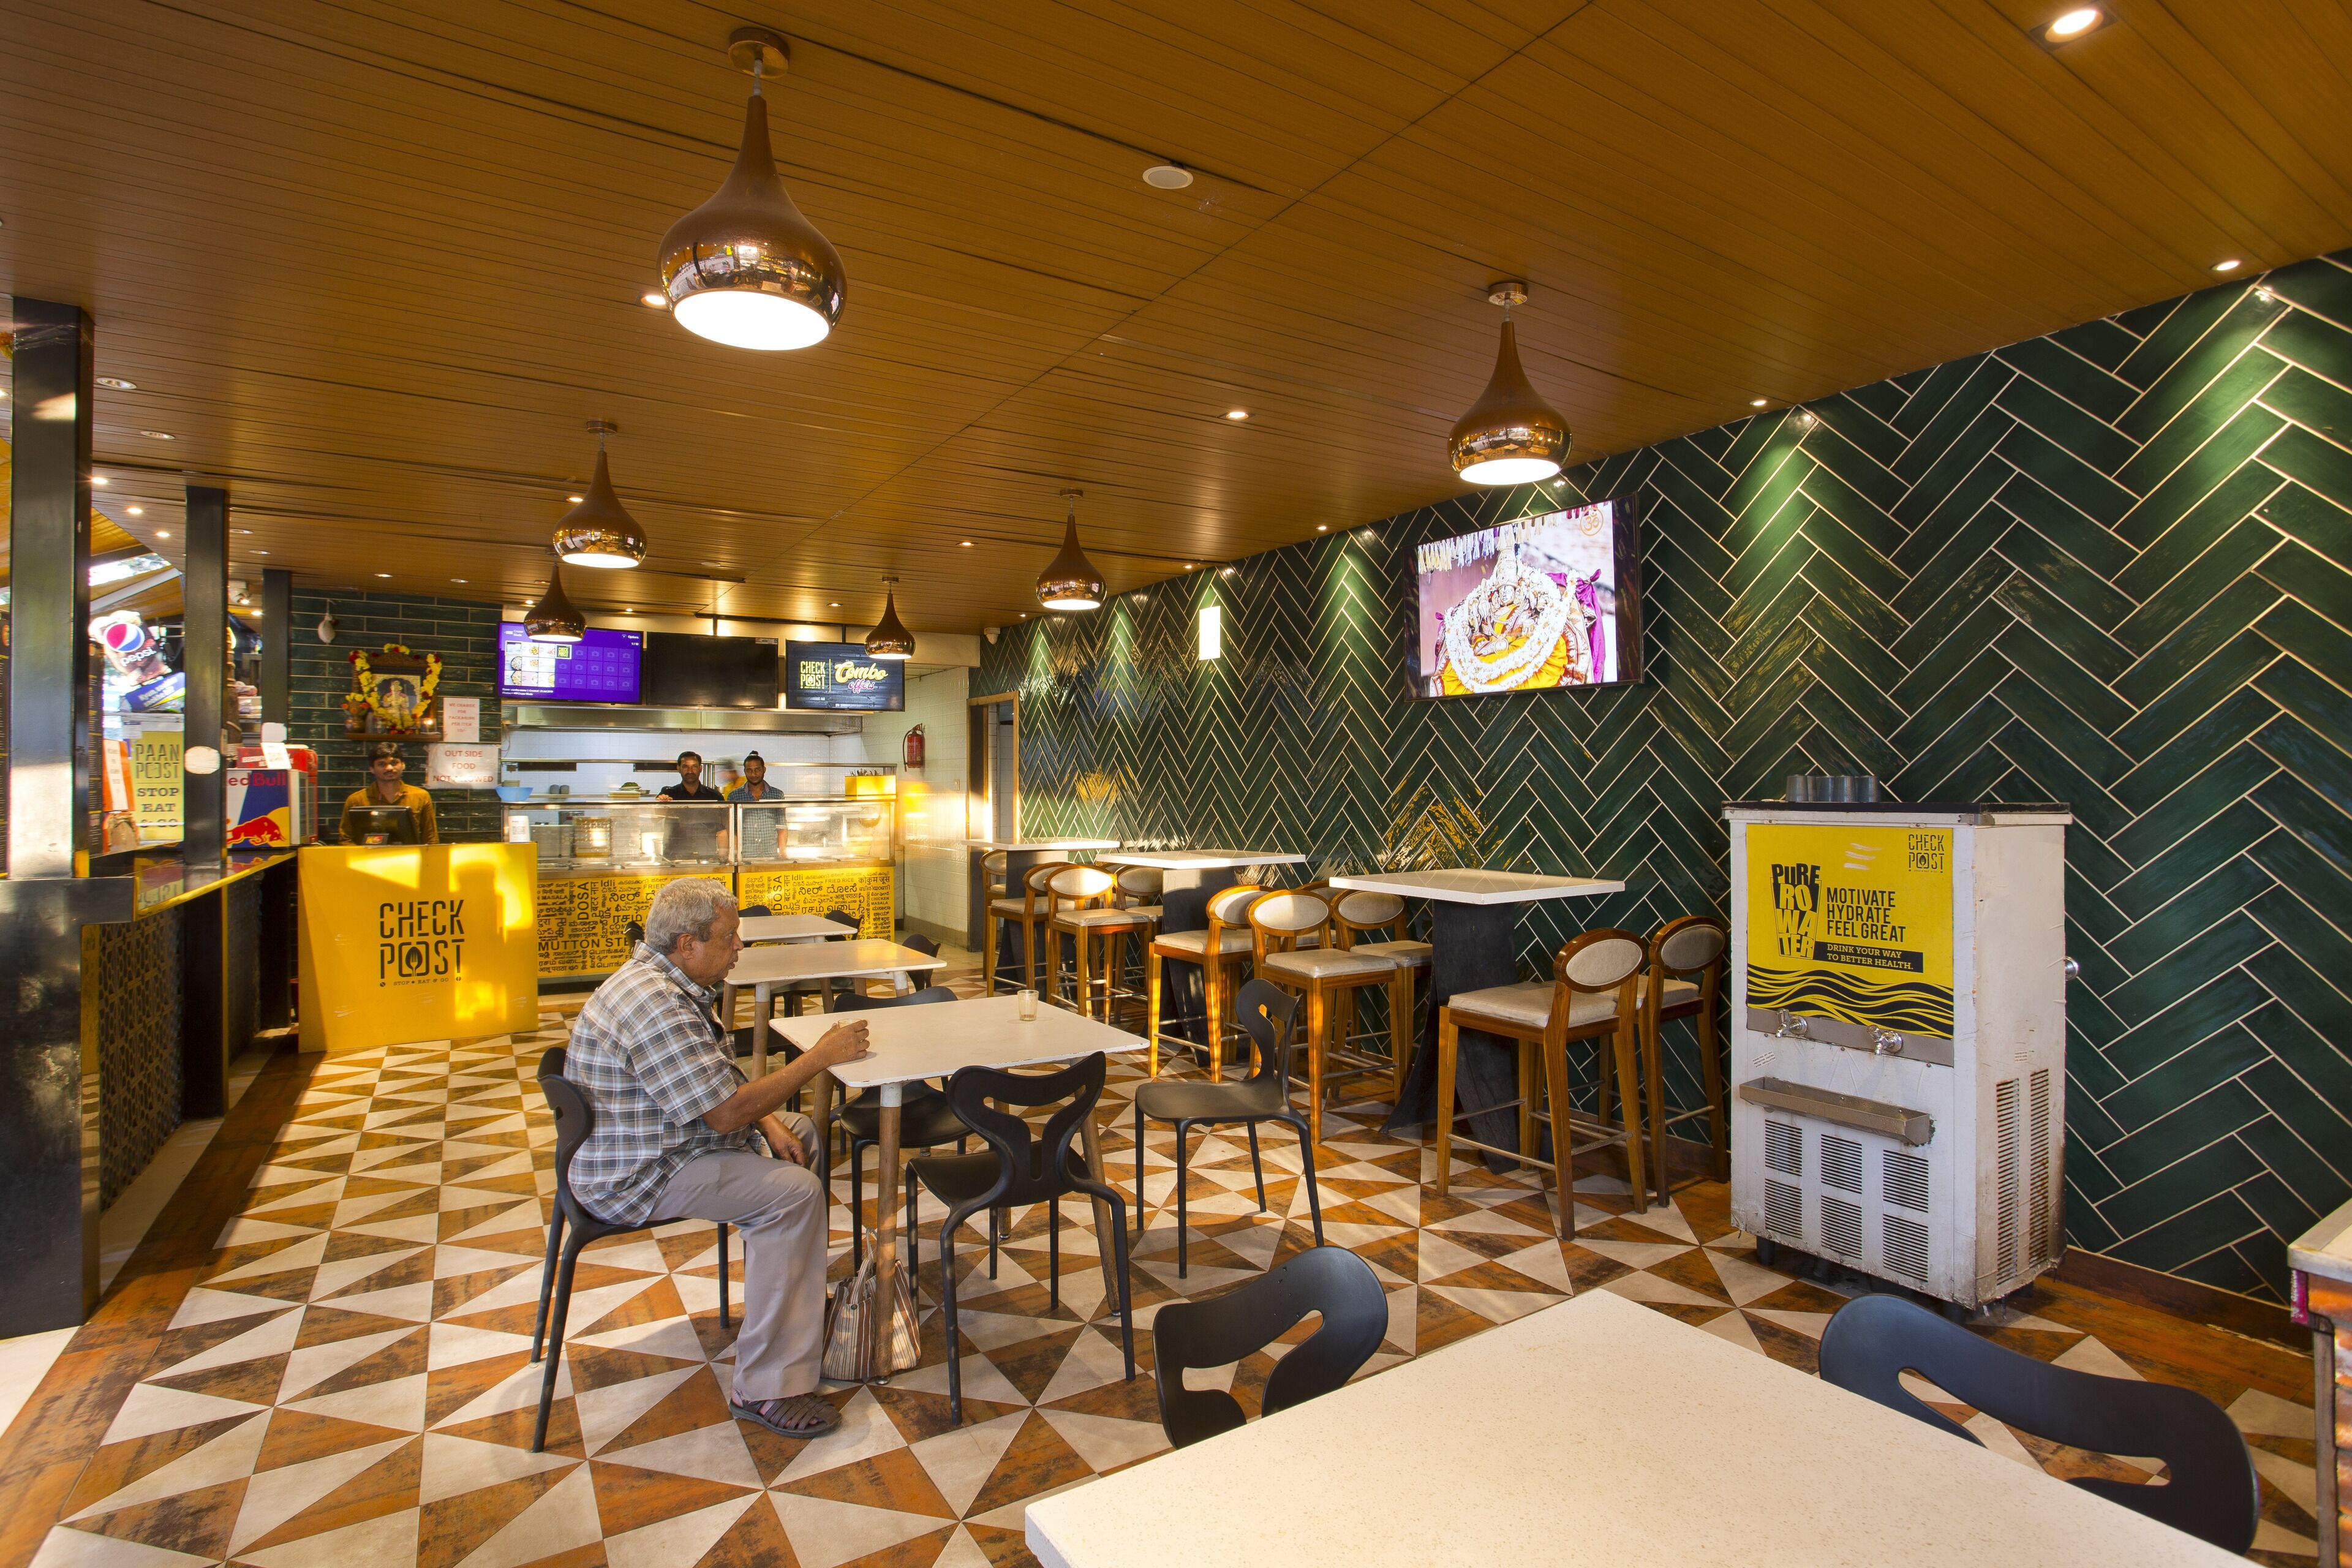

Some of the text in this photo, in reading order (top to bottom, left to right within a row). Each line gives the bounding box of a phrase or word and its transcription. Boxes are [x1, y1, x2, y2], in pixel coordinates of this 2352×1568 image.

[800, 661, 826, 674] CHECK
[834, 660, 888, 684] Combo
[800, 674, 826, 687] POST
[848, 679, 875, 693] offers
[136, 744, 179, 761] PAAN
[136, 762, 179, 778] POST
[228, 772, 286, 786] ed Bull
[137, 788, 179, 797] STOP
[141, 803, 176, 812] EAT
[1909, 834, 1944, 851] CHECK
[1909, 852, 1944, 870] POST
[859, 875, 878, 885] कोकुम
[879, 876, 891, 884] जूस
[1771, 863, 1820, 886] PURE
[773, 875, 782, 911] DOSA
[799, 886, 823, 895] ನೀರ್
[827, 883, 857, 893] ದೋಸೆ
[577, 881, 589, 920] DOSA
[1779, 884, 1812, 911] RO
[1826, 887, 1896, 908] MOTIVATE
[802, 903, 824, 914] ரசம்
[1826, 903, 1891, 924] HYDRATE
[380, 899, 464, 938] CHECK
[1827, 919, 1905, 943] FEEL GREAT
[538, 937, 629, 951] MUTTON STE
[1827, 944, 1902, 959] DRINK YOUR WAY
[380, 938, 465, 979] POST
[1840, 955, 1872, 965] BETTER
[1874, 959, 1913, 970] HEALTH.
